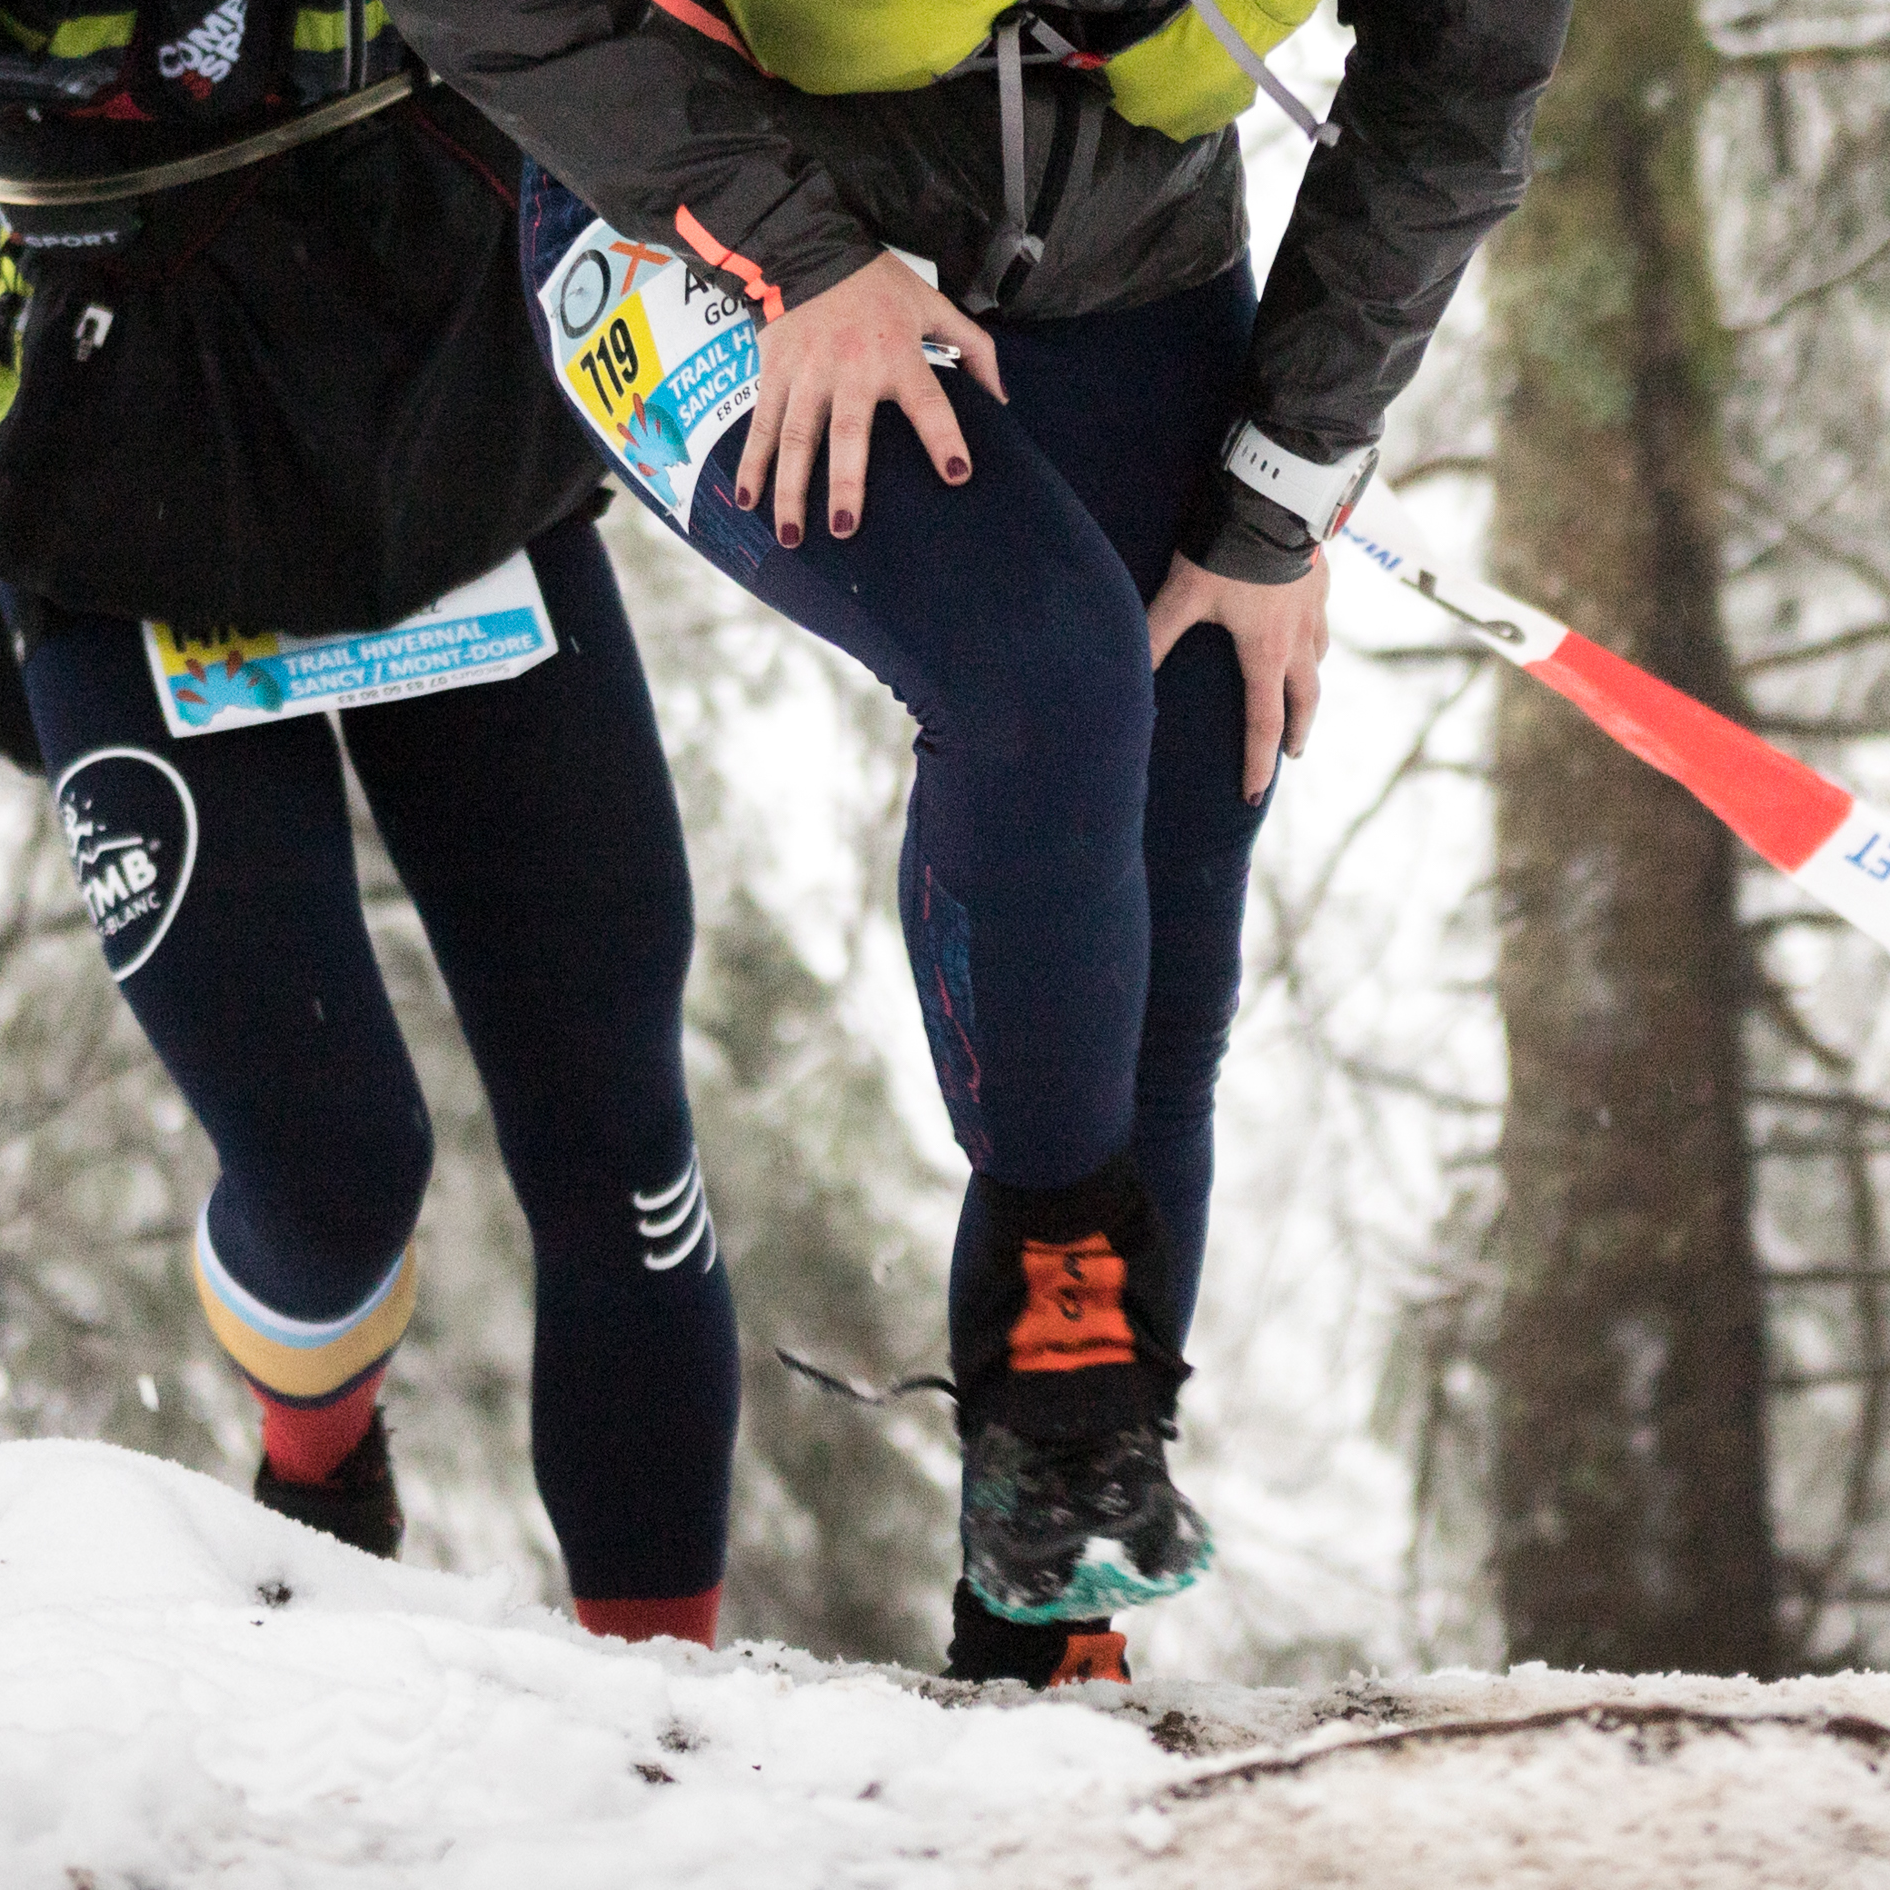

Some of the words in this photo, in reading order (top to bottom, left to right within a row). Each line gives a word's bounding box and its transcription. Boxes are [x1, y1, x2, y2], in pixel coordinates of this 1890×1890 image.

[579, 317, 639, 417] 719
[667, 343, 730, 401] TRAIL
[678, 361, 738, 428] SANCY
[284, 648, 357, 677] TRAIL
[358, 621, 488, 662] HIVERNAL
[289, 668, 366, 697] SANCY
[388, 633, 537, 678] MONT-DORE
